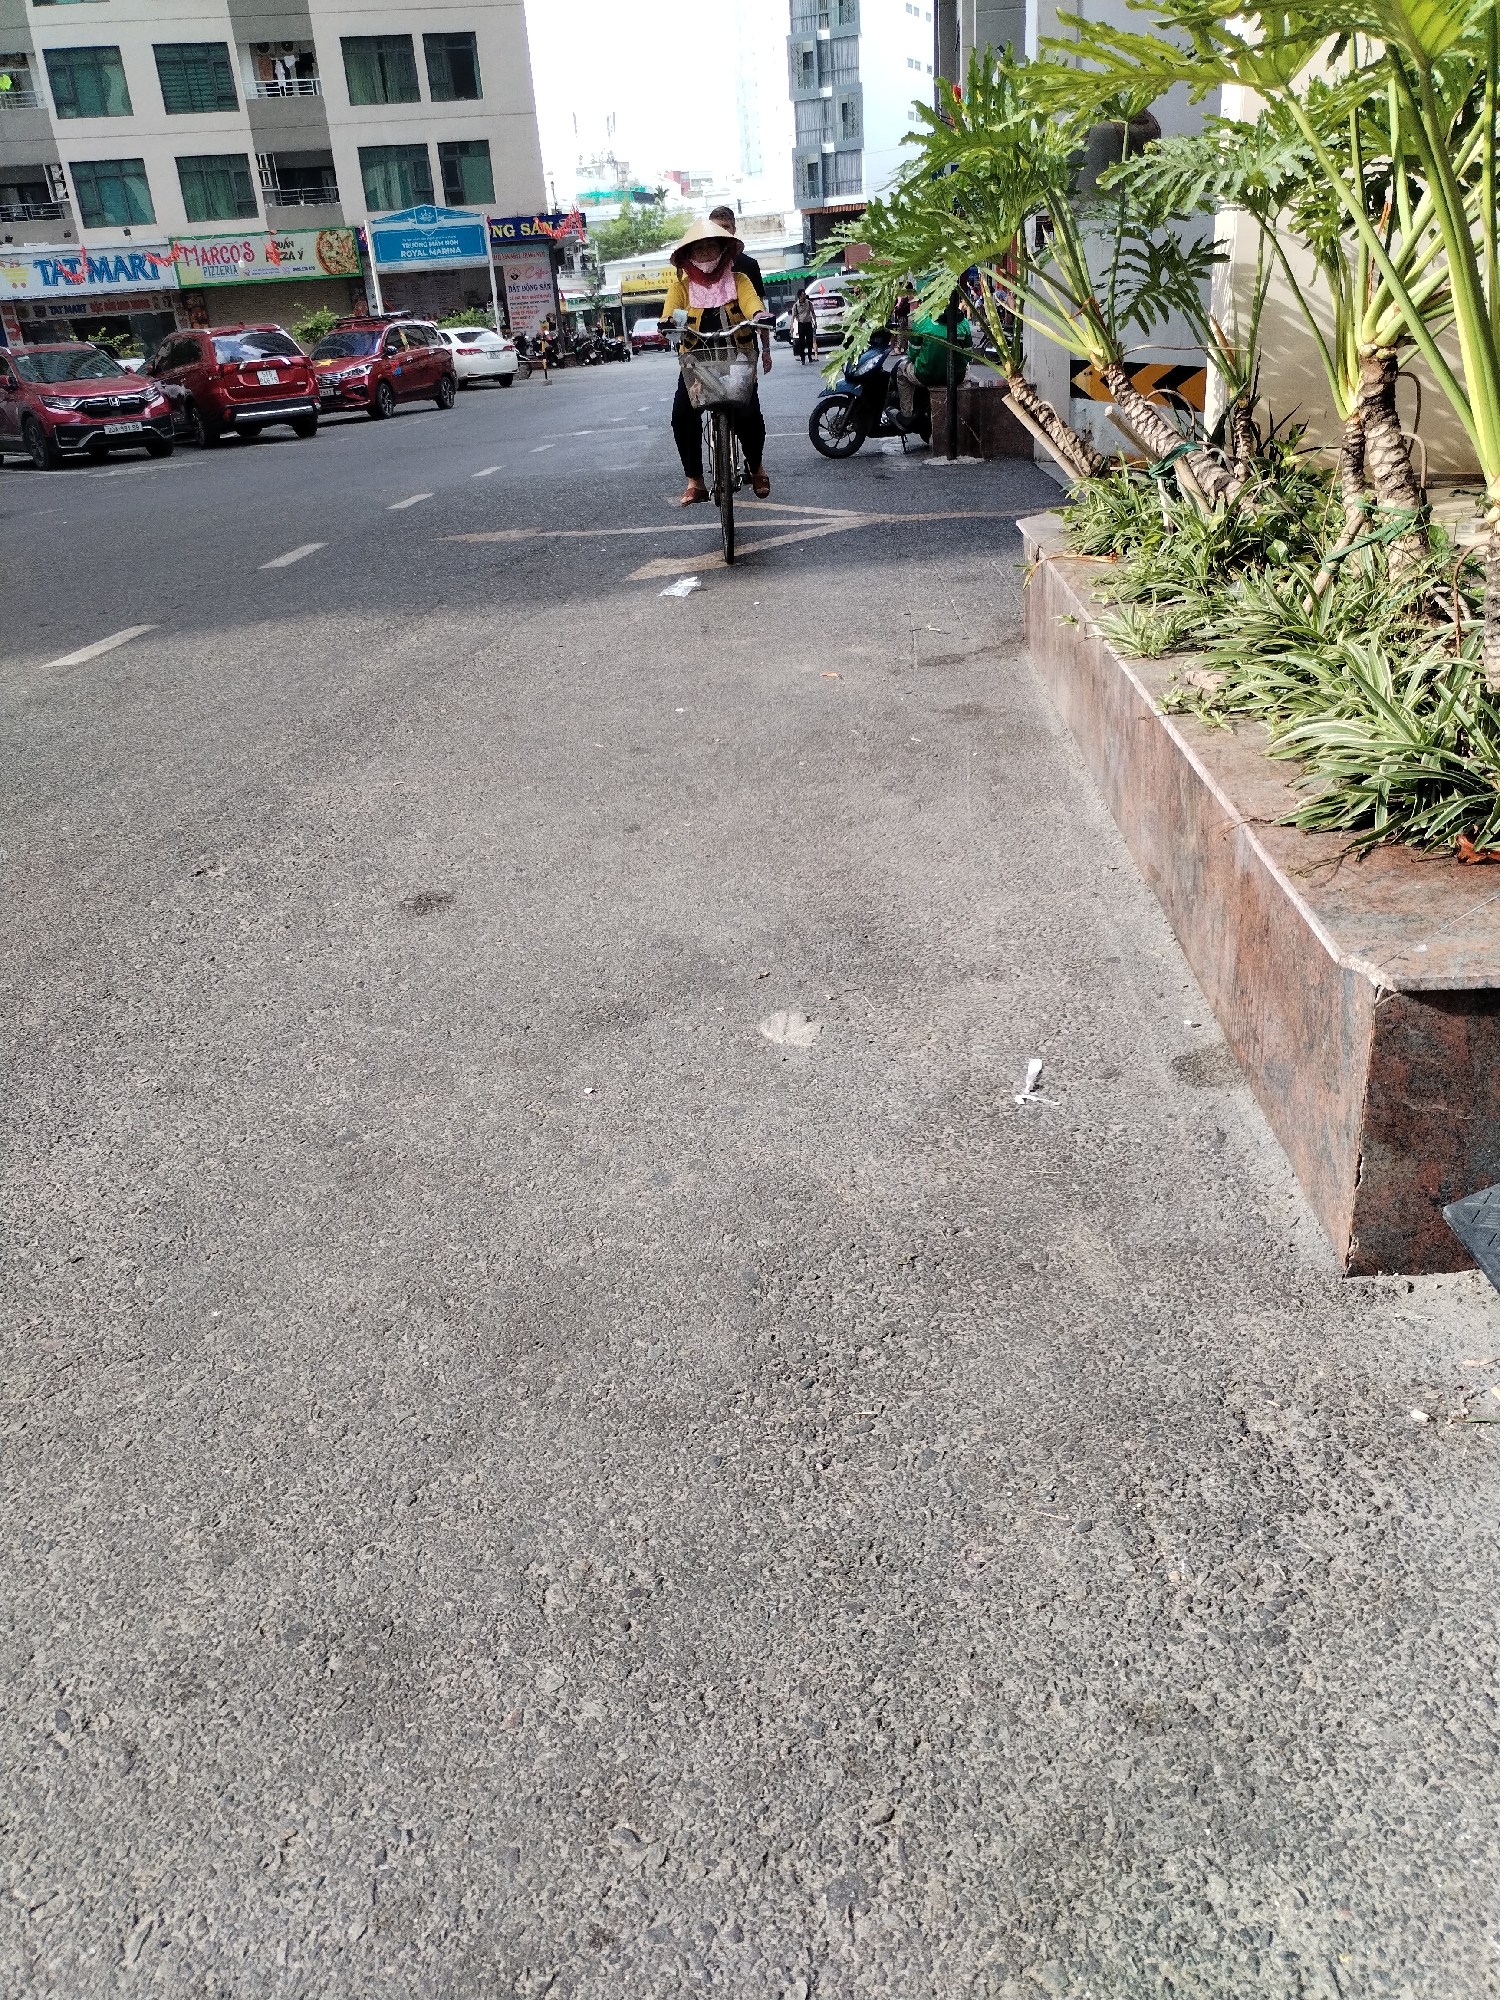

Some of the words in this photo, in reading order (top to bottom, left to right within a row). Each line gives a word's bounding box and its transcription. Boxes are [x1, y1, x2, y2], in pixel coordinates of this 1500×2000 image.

[491, 224, 516, 238] NG
[180, 241, 255, 267] MARCO'S
[400, 249, 428, 258] ROYAL
[428, 246, 462, 256] MARINA
[86, 253, 160, 284] MART
[203, 264, 239, 278] PIZZERIA
[66, 303, 87, 314] MART
